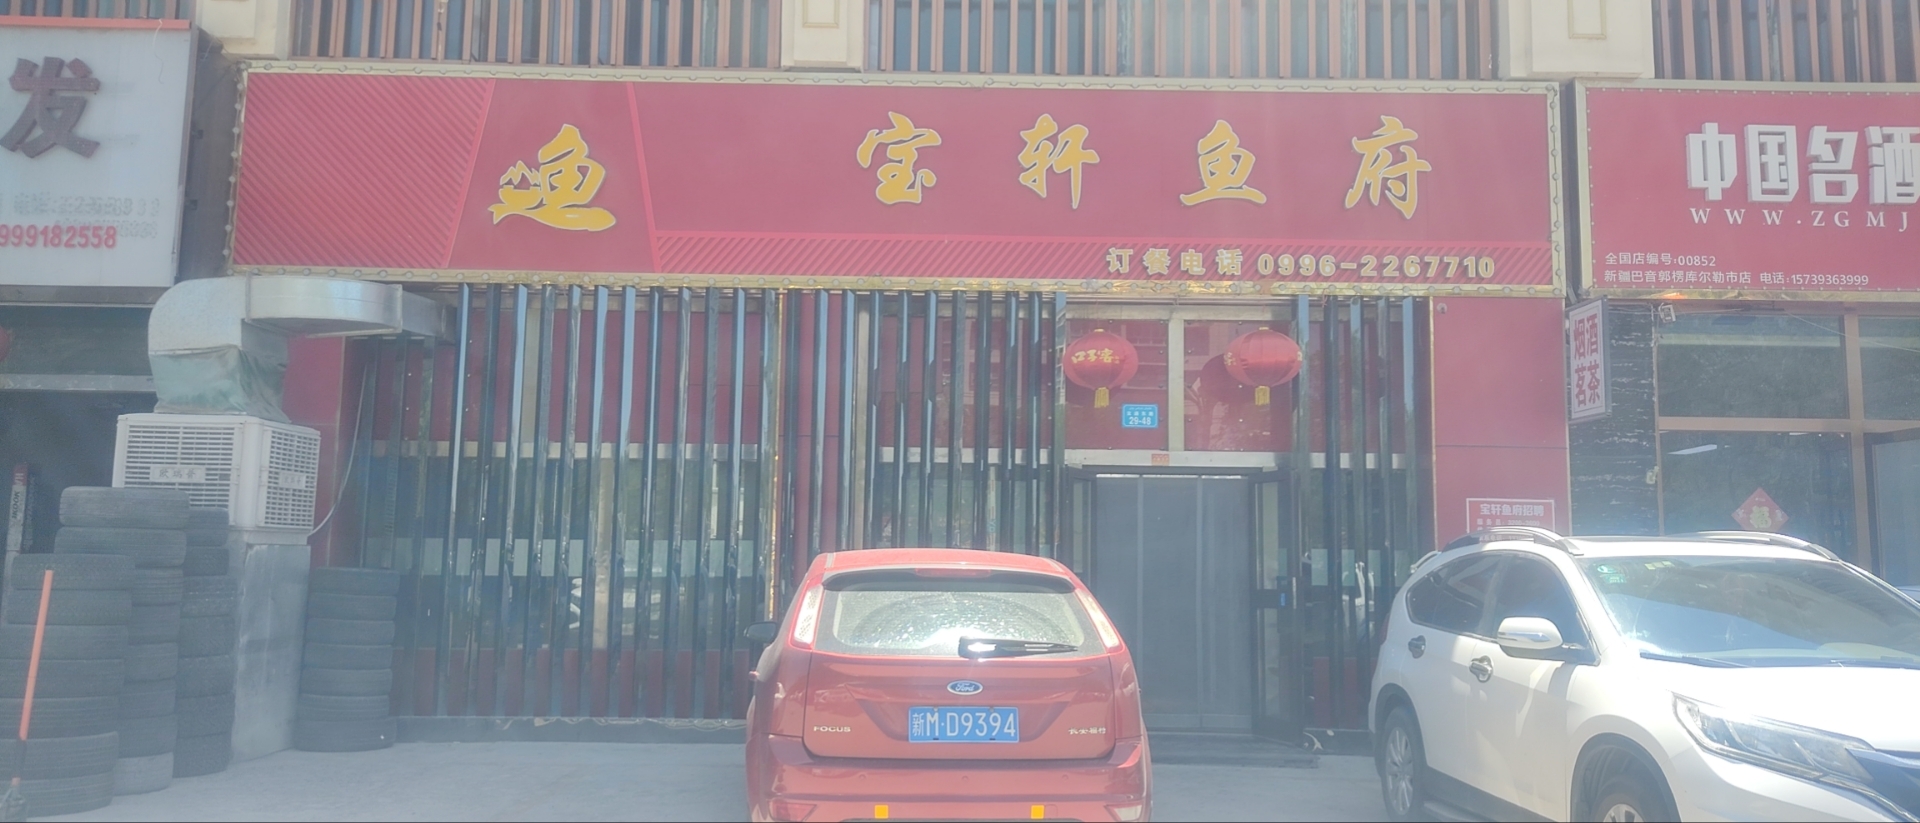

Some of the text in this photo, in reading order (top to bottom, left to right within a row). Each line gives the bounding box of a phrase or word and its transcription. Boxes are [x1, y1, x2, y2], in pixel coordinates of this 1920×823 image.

[0, 56, 101, 158] 发
[856, 111, 1431, 219] 宝轩鱼府
[1686, 122, 1920, 205] 中国名酒
[0, 223, 117, 249] 999182558
[1106, 247, 1496, 278] 订餐电话 0996-2267710
[1603, 269, 1752, 284] 新疆巴音郭楞库尔勒市店
[1480, 503, 1544, 516] 宝轩鱼府招聘
[955, 682, 976, 692] Ford
[813, 725, 851, 733] FOCUS
